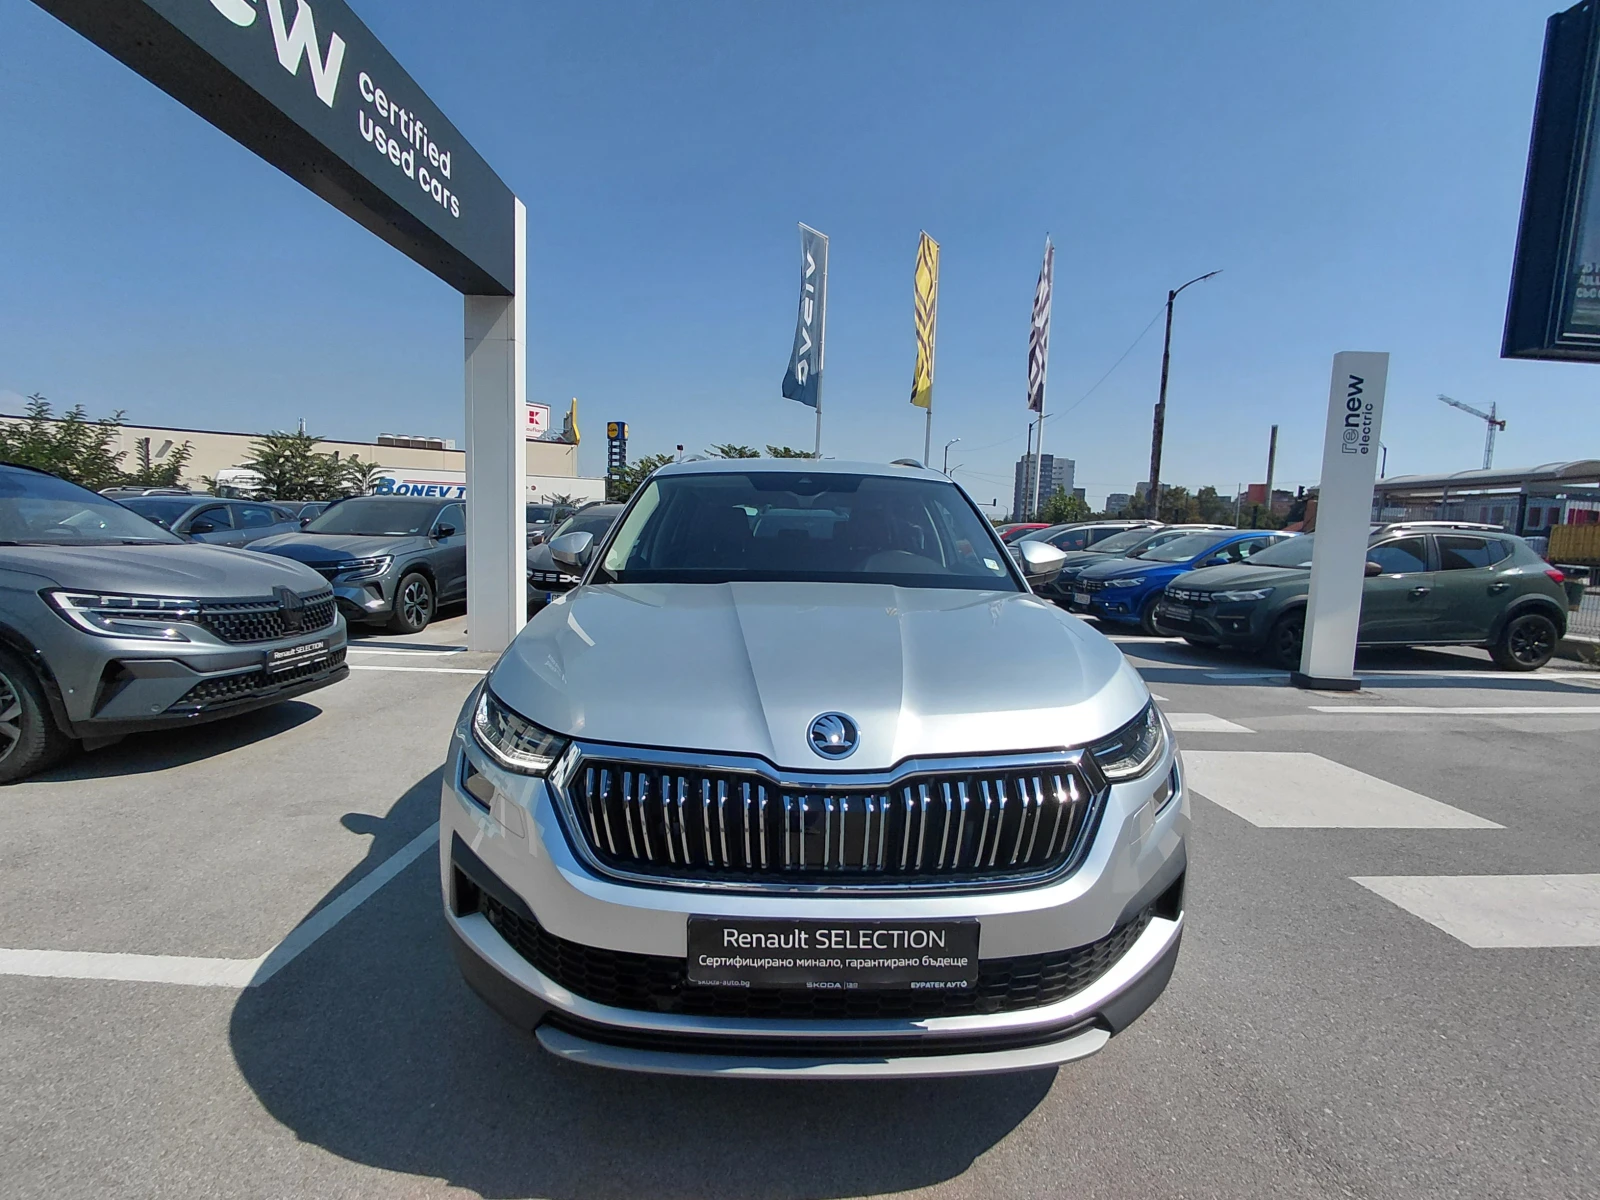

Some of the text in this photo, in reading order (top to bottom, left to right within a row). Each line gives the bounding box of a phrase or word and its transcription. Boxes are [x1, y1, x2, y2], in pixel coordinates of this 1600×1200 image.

[358, 71, 451, 180] certified
[359, 109, 460, 218] used cars
[1341, 374, 1364, 454] renew
[1358, 403, 1373, 455] electric
[273, 648, 296, 659] Renault
[295, 641, 324, 654] SELECTION
[698, 954, 968, 970] Сертифицирано минало, гарантирано бъдеще
[723, 928, 945, 949] Renault SELECTION
